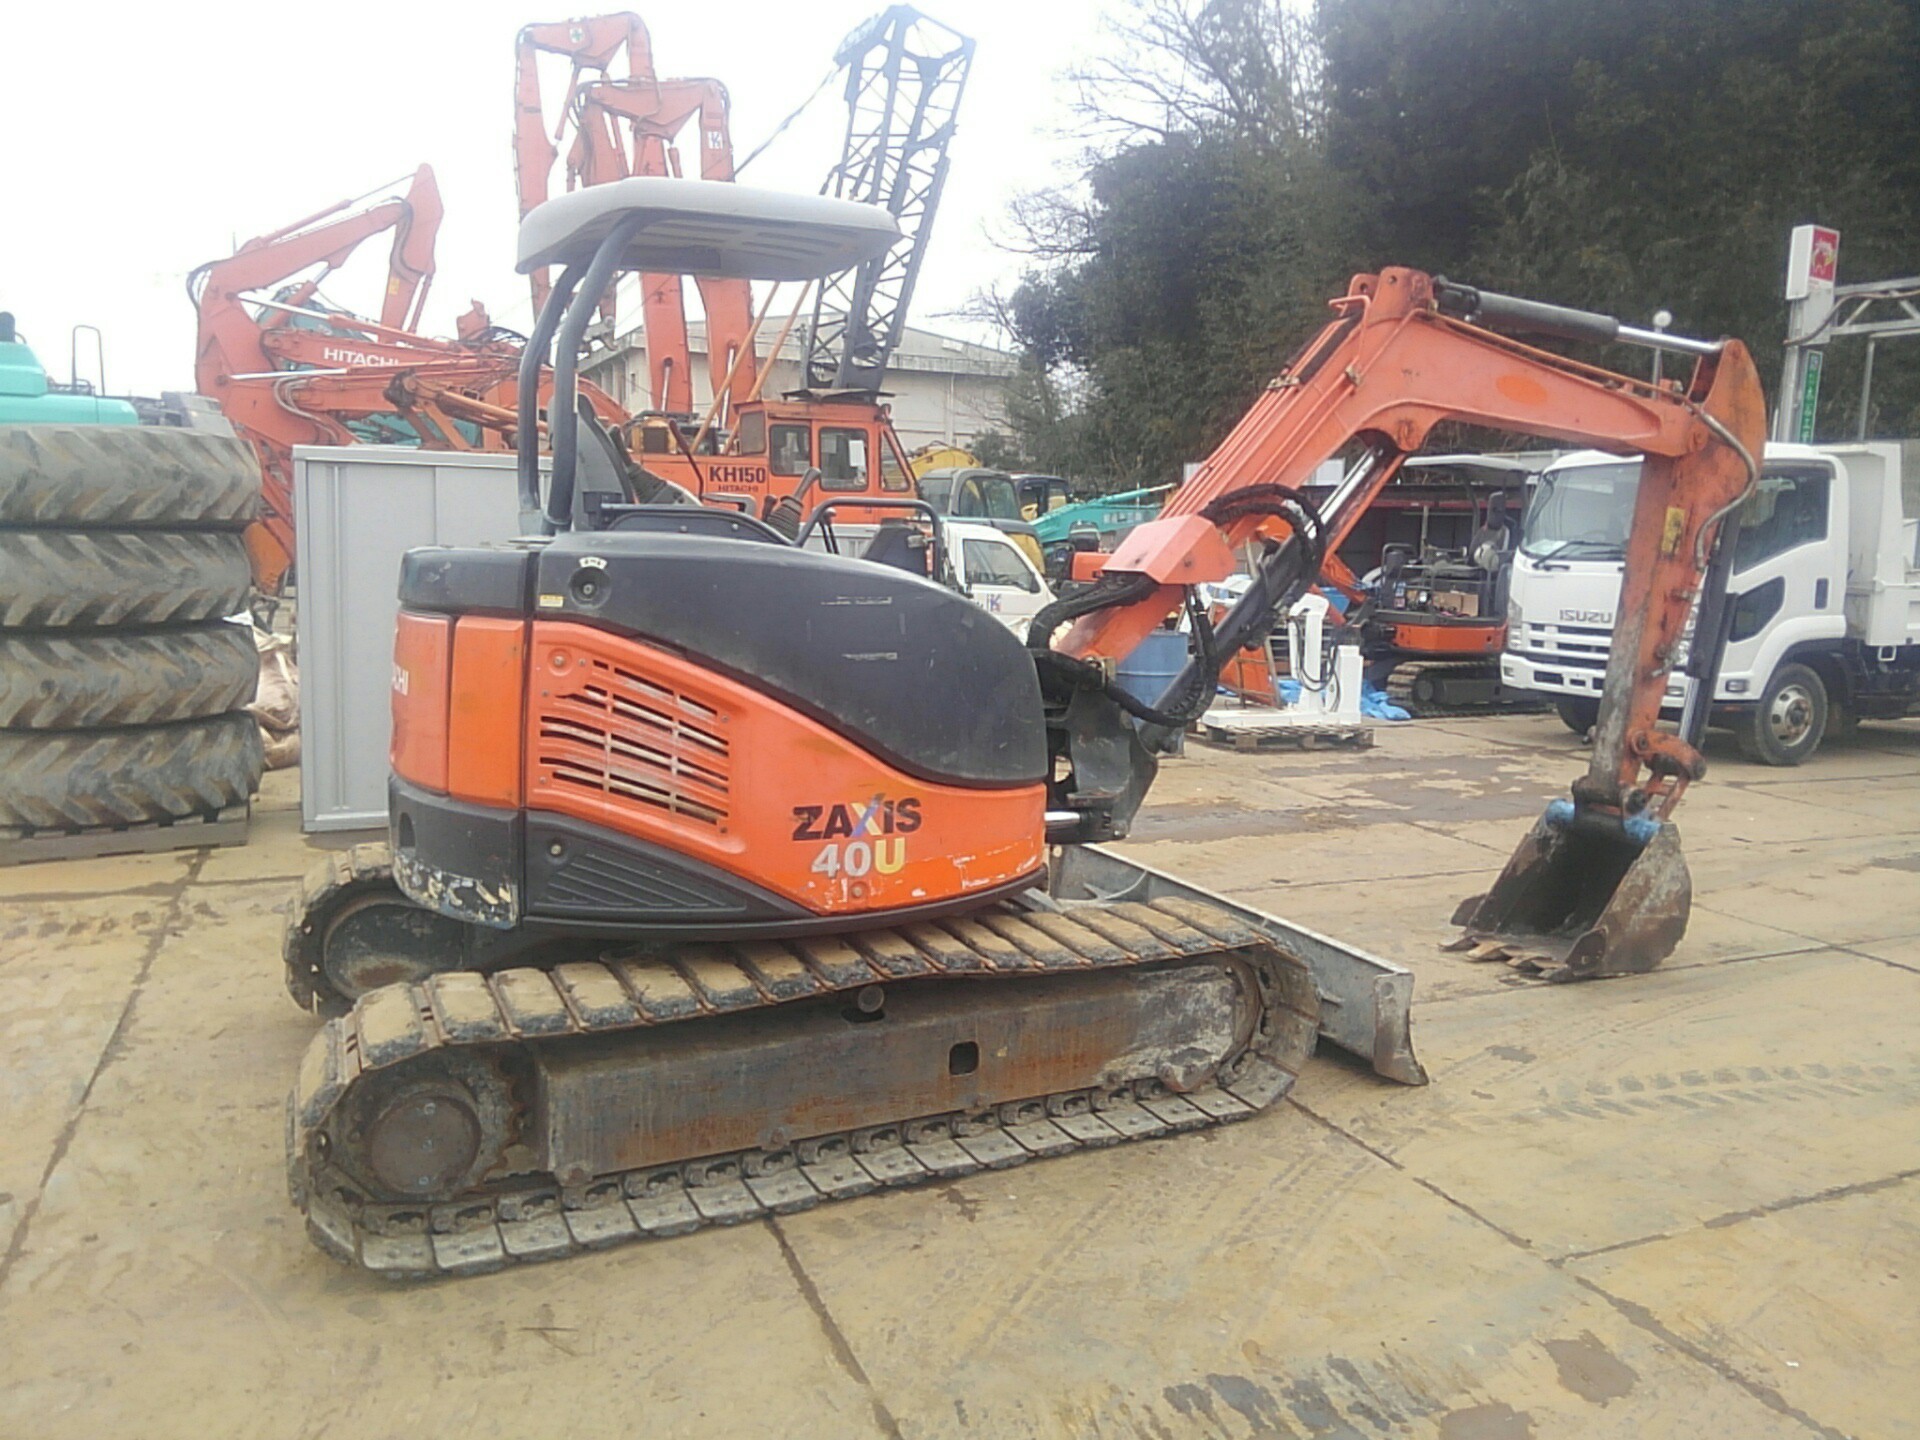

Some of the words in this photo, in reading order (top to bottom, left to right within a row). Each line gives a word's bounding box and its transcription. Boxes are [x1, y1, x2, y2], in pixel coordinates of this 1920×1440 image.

[323, 347, 399, 367] HITACHI
[709, 466, 766, 483] KH150
[1559, 609, 1612, 624] ISUZU
[792, 793, 922, 841] ZAXIS
[811, 837, 905, 878] 40U
